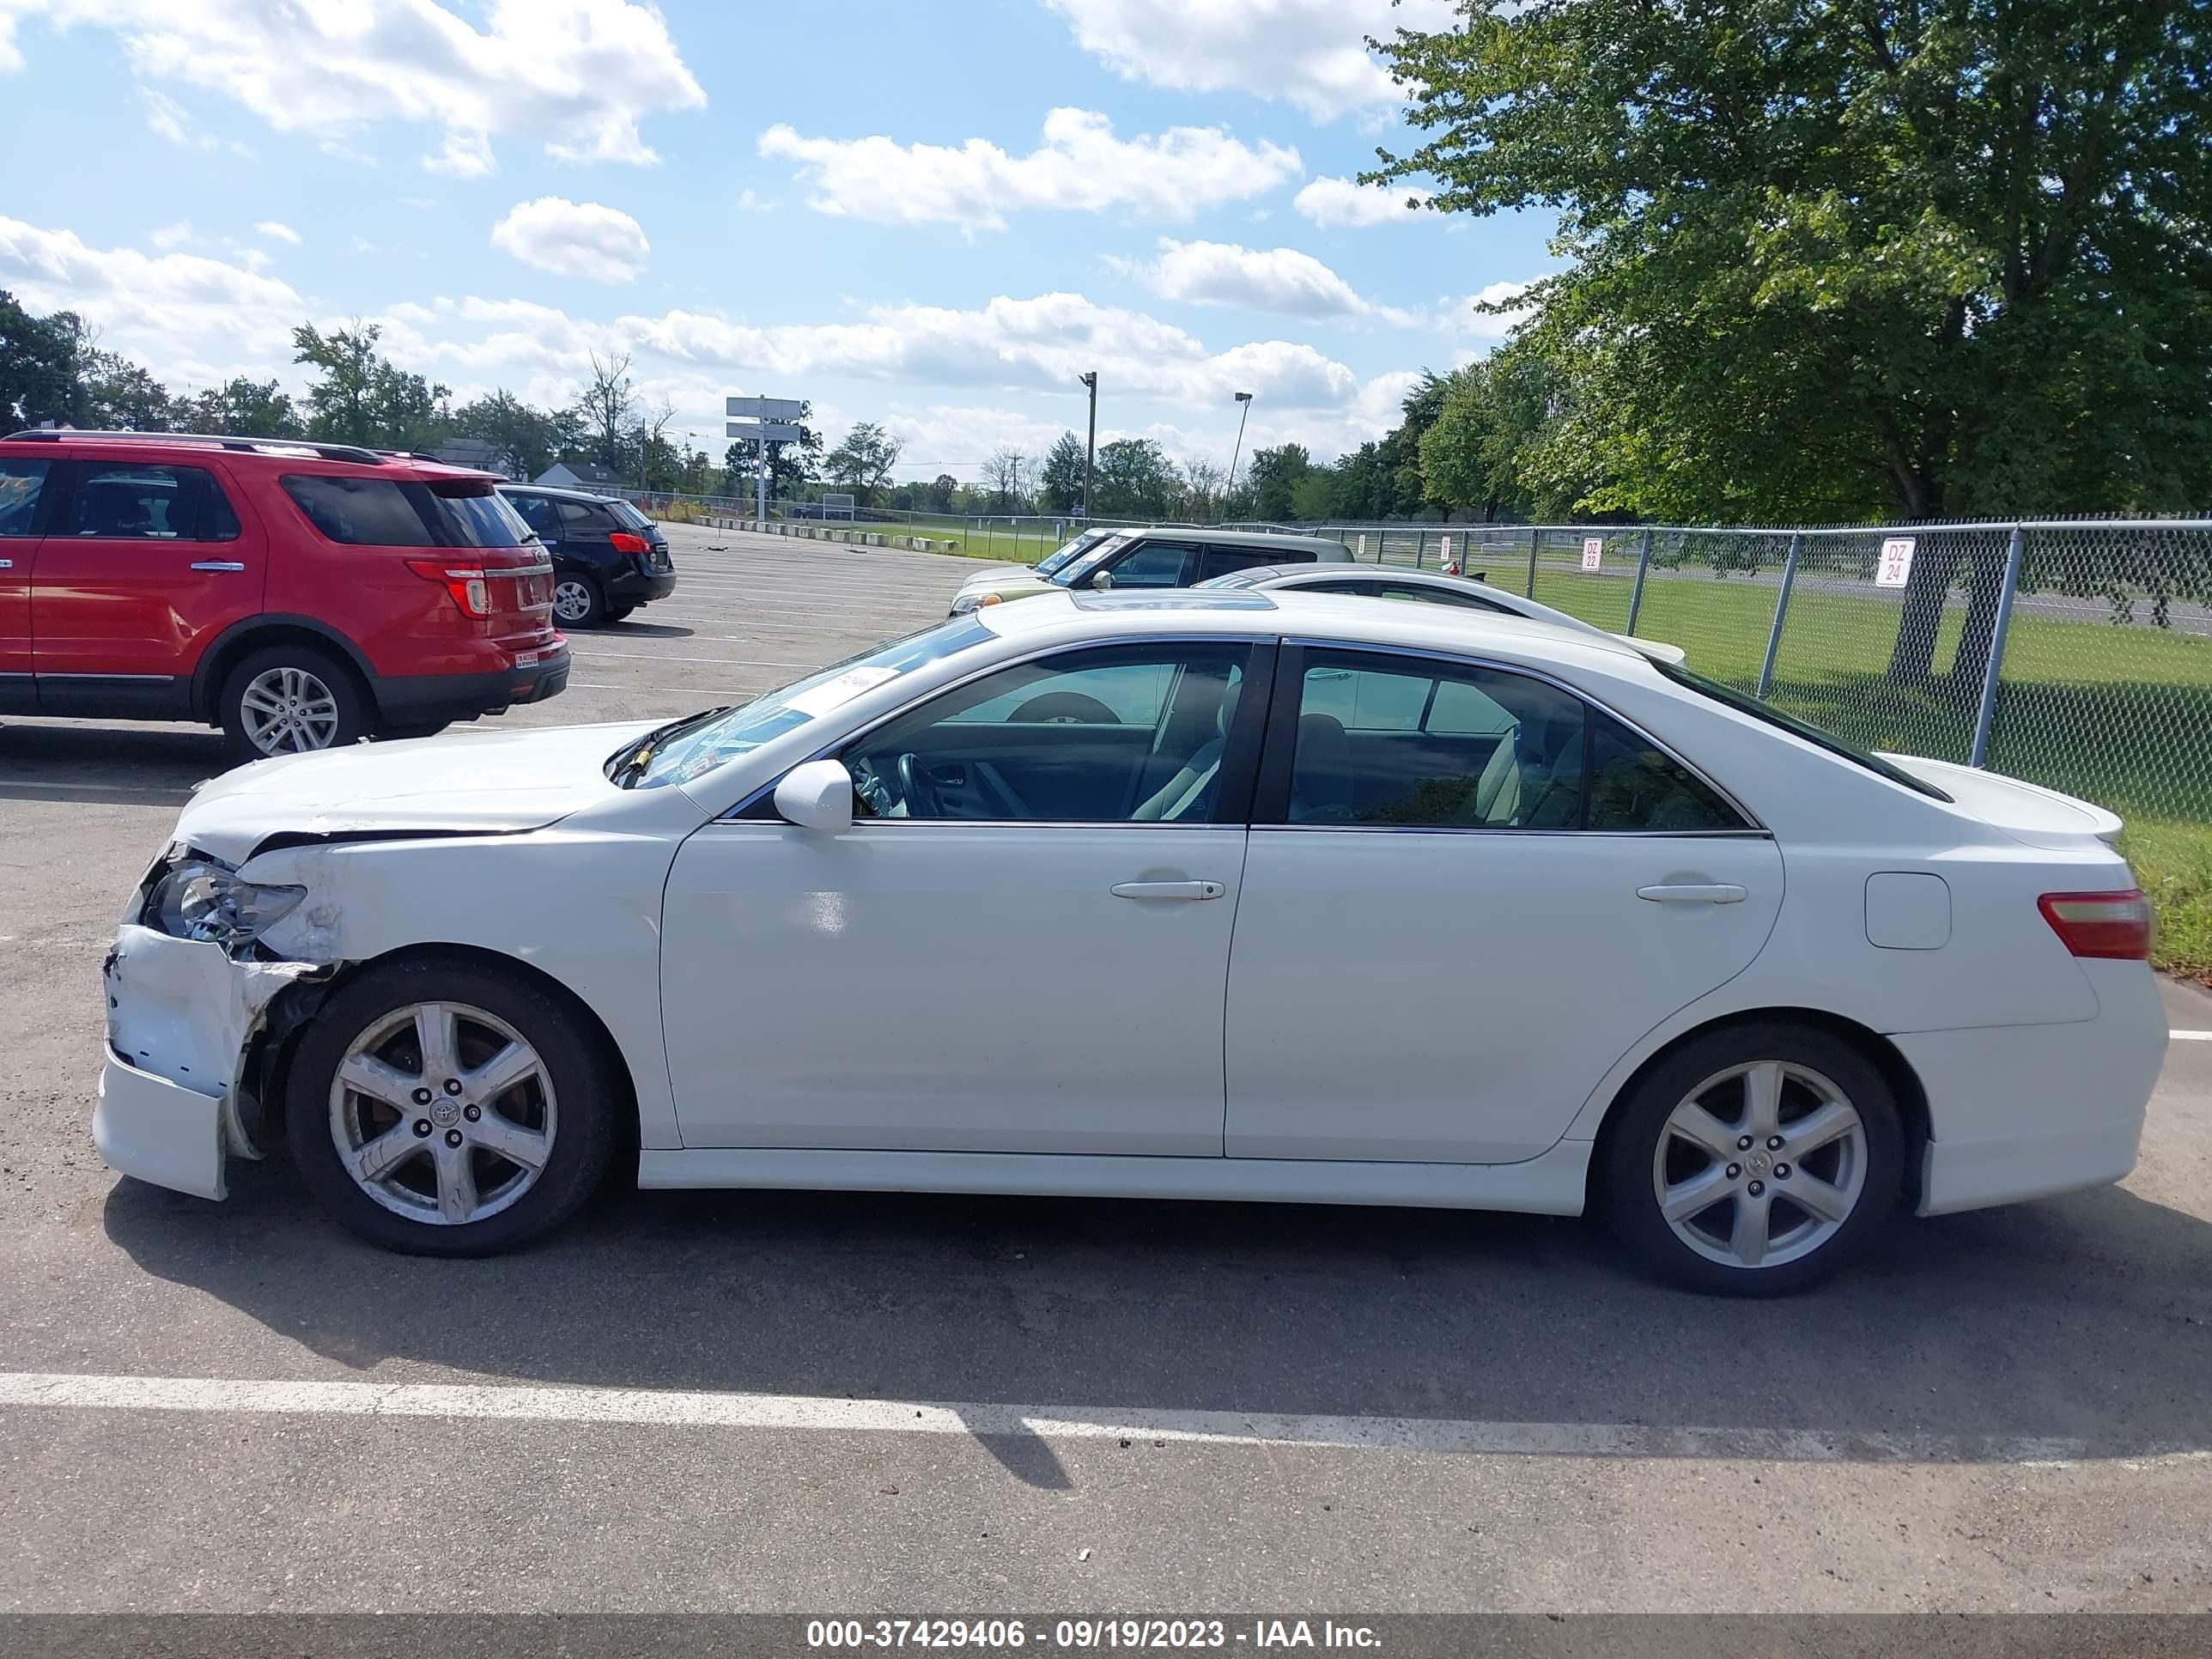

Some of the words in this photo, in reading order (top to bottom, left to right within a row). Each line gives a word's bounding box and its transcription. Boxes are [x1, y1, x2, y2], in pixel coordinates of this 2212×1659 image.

[1587, 542, 1598, 554] DZ
[1888, 544, 1907, 561] DZ
[1586, 555, 1596, 567] 22
[1886, 563, 1900, 580] 24
